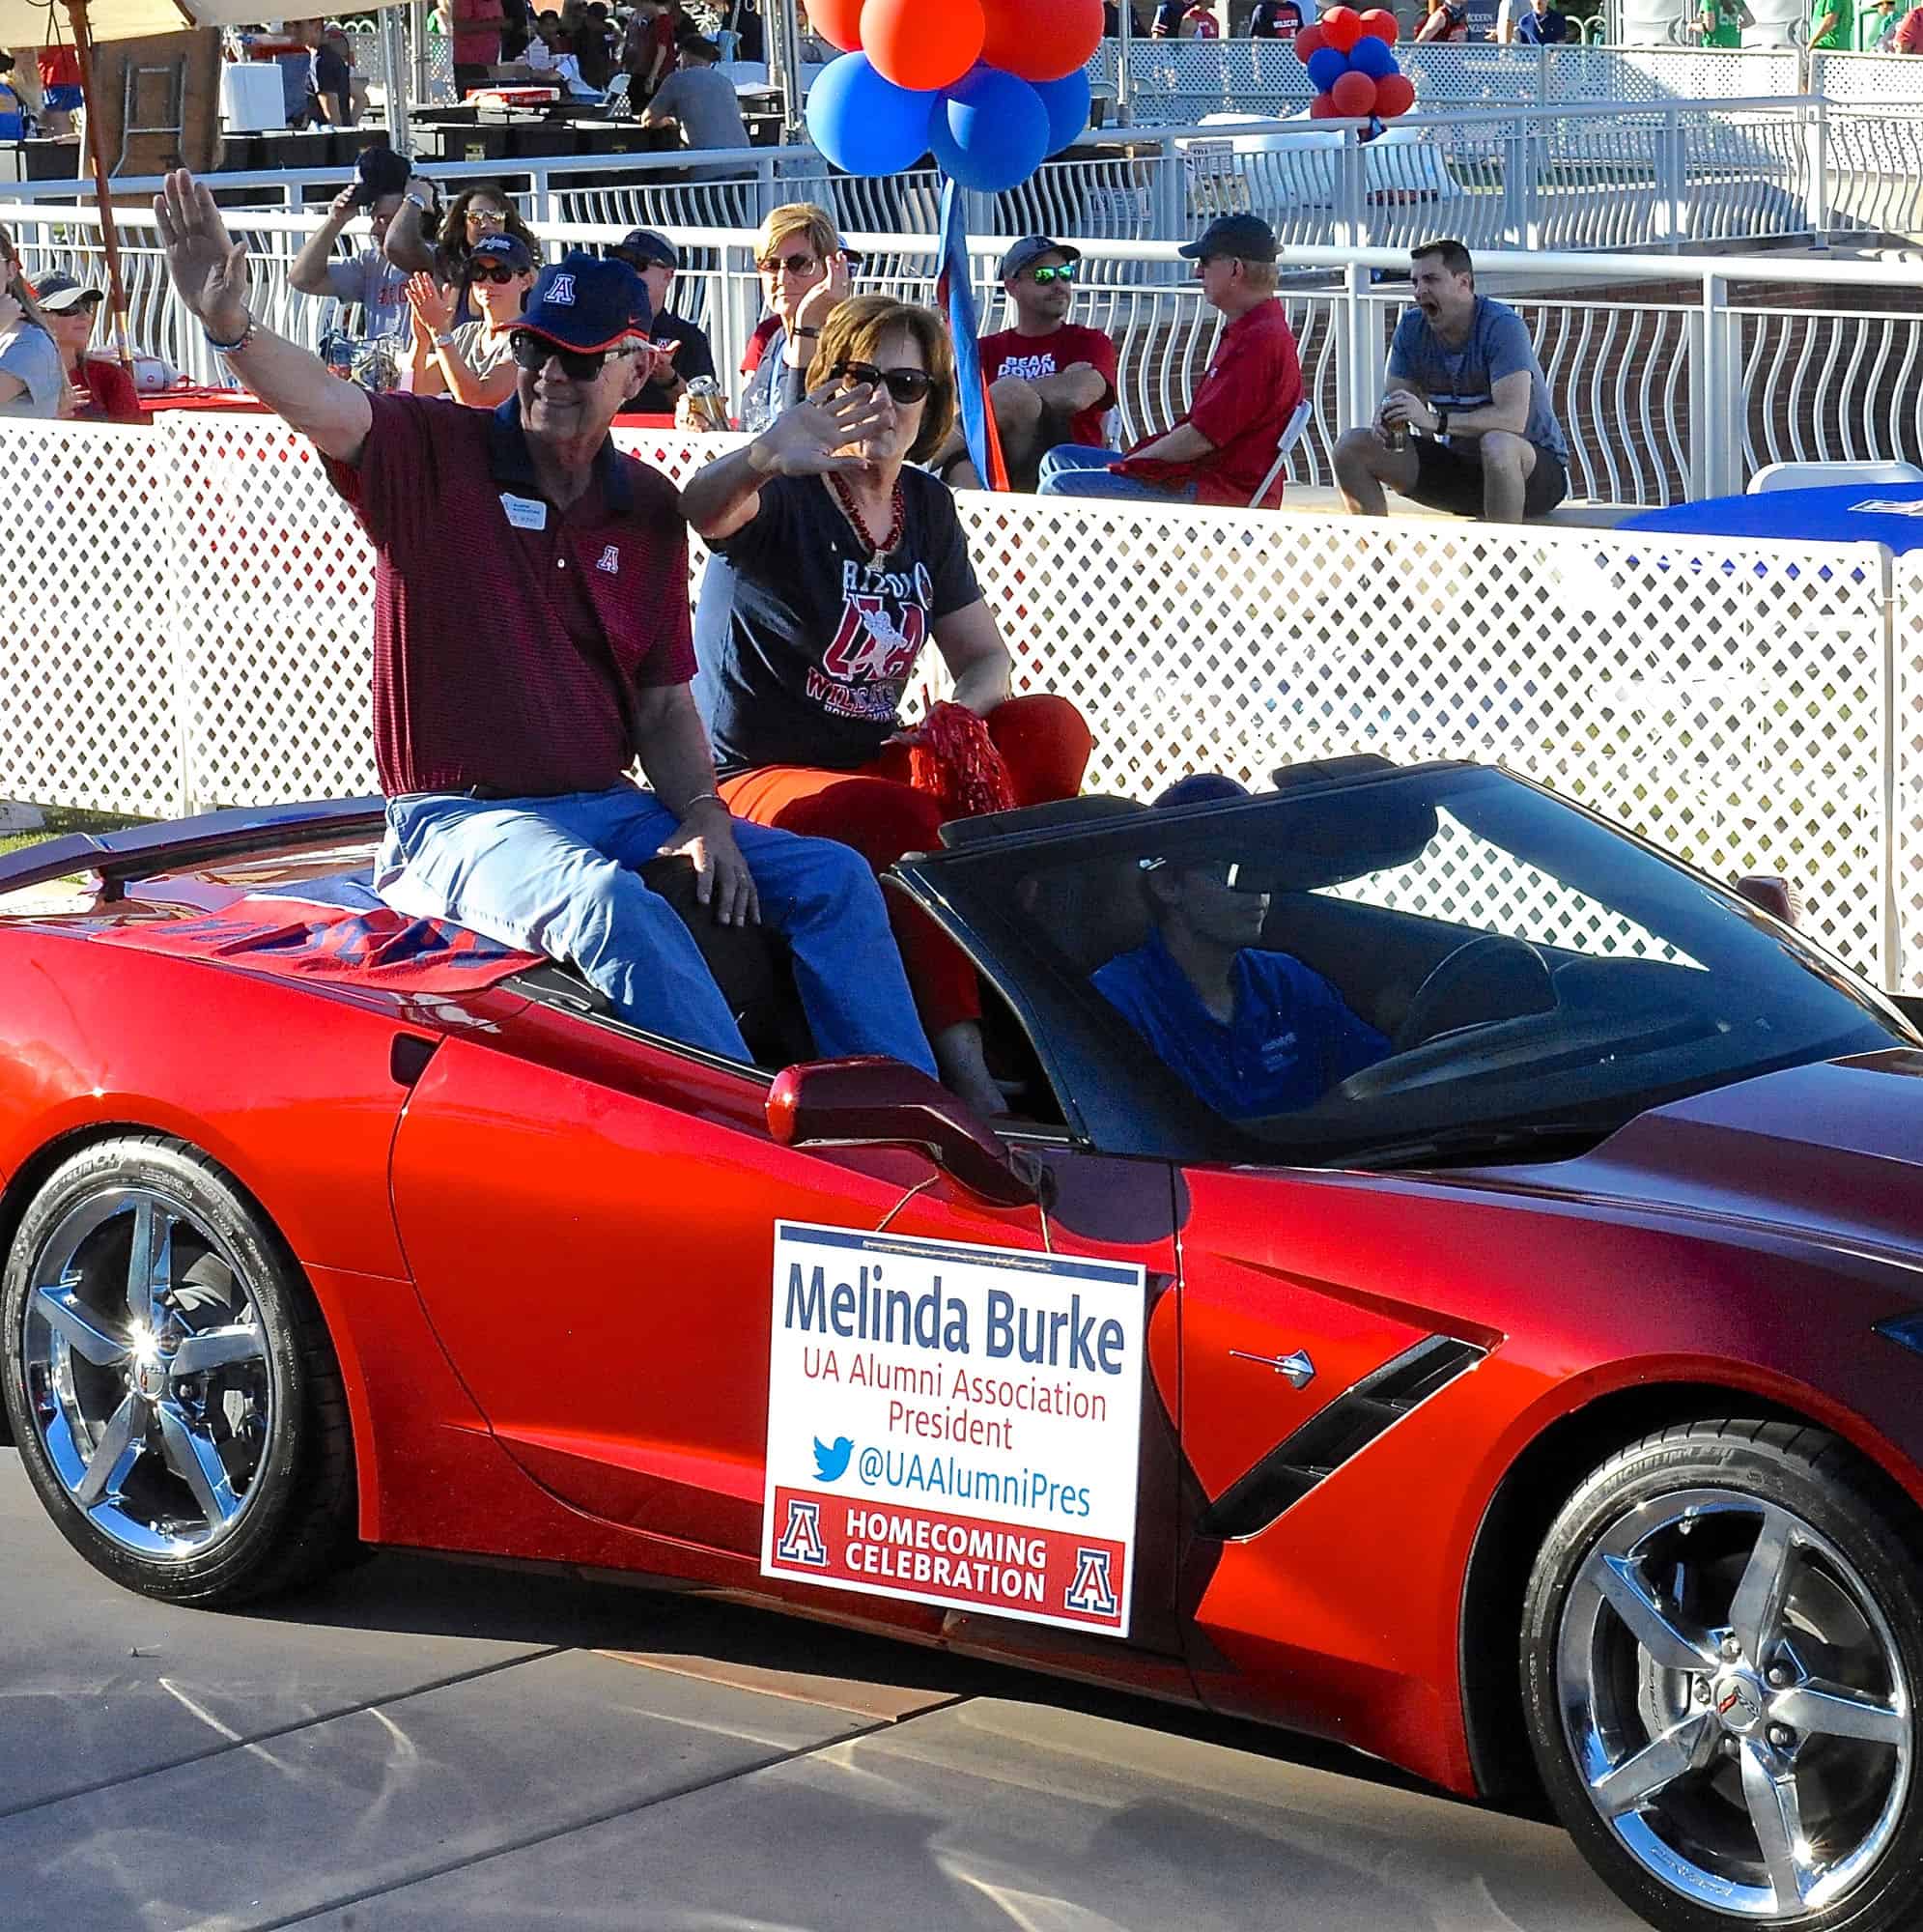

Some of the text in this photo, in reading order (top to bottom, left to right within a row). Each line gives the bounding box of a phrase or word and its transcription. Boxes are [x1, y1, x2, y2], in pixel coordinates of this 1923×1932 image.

[544, 273, 577, 306] A
[998, 361, 1056, 380] DOWN
[596, 545, 619, 574] A
[785, 1263, 1124, 1375] Melinda Burke
[804, 1347, 1107, 1422] UA Alumni Association
[890, 1400, 1013, 1450] President
[859, 1447, 1090, 1518] @UAAlumniPres
[777, 1498, 827, 1567] A
[846, 1509, 1047, 1569] HOMECOMING
[845, 1542, 1045, 1602] CELEBRATION
[1064, 1547, 1117, 1618] A
